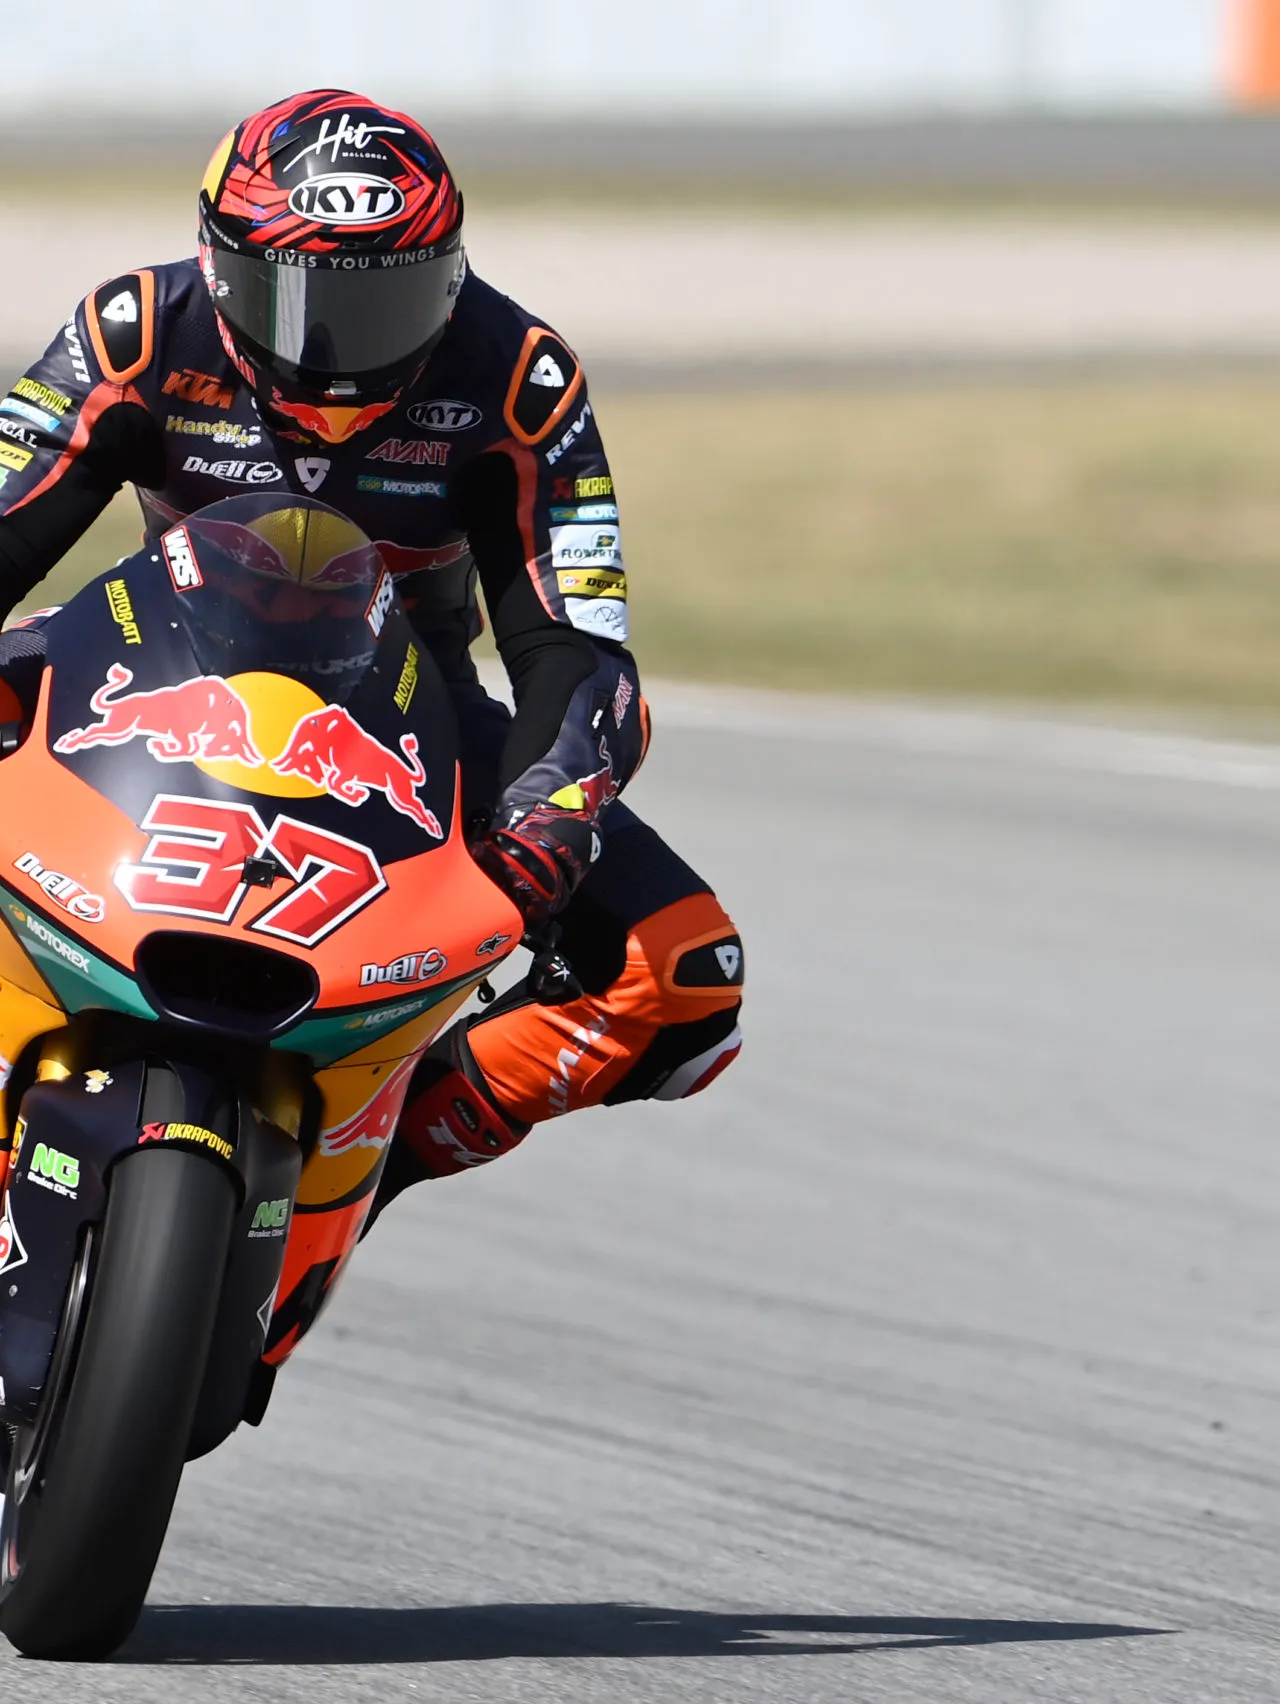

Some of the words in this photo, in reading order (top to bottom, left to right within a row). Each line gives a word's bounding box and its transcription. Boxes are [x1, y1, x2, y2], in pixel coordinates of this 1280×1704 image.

[283, 114, 405, 173] Hit
[303, 185, 391, 214] KYT
[265, 249, 317, 269] GIVES
[330, 256, 369, 269] YOU
[381, 247, 436, 267] WINGS
[161, 368, 235, 410] KTM
[165, 415, 242, 436] Handy
[365, 438, 451, 466] AVANT
[105, 579, 142, 645] MOTOBATT
[113, 793, 388, 948] 37
[25, 914, 91, 974] MOTOREX
[165, 1122, 233, 1160] AKRAPOVIC
[27, 1171, 55, 1190] Brake
[30, 1142, 80, 1189] NG
[250, 1198, 289, 1229] NG
